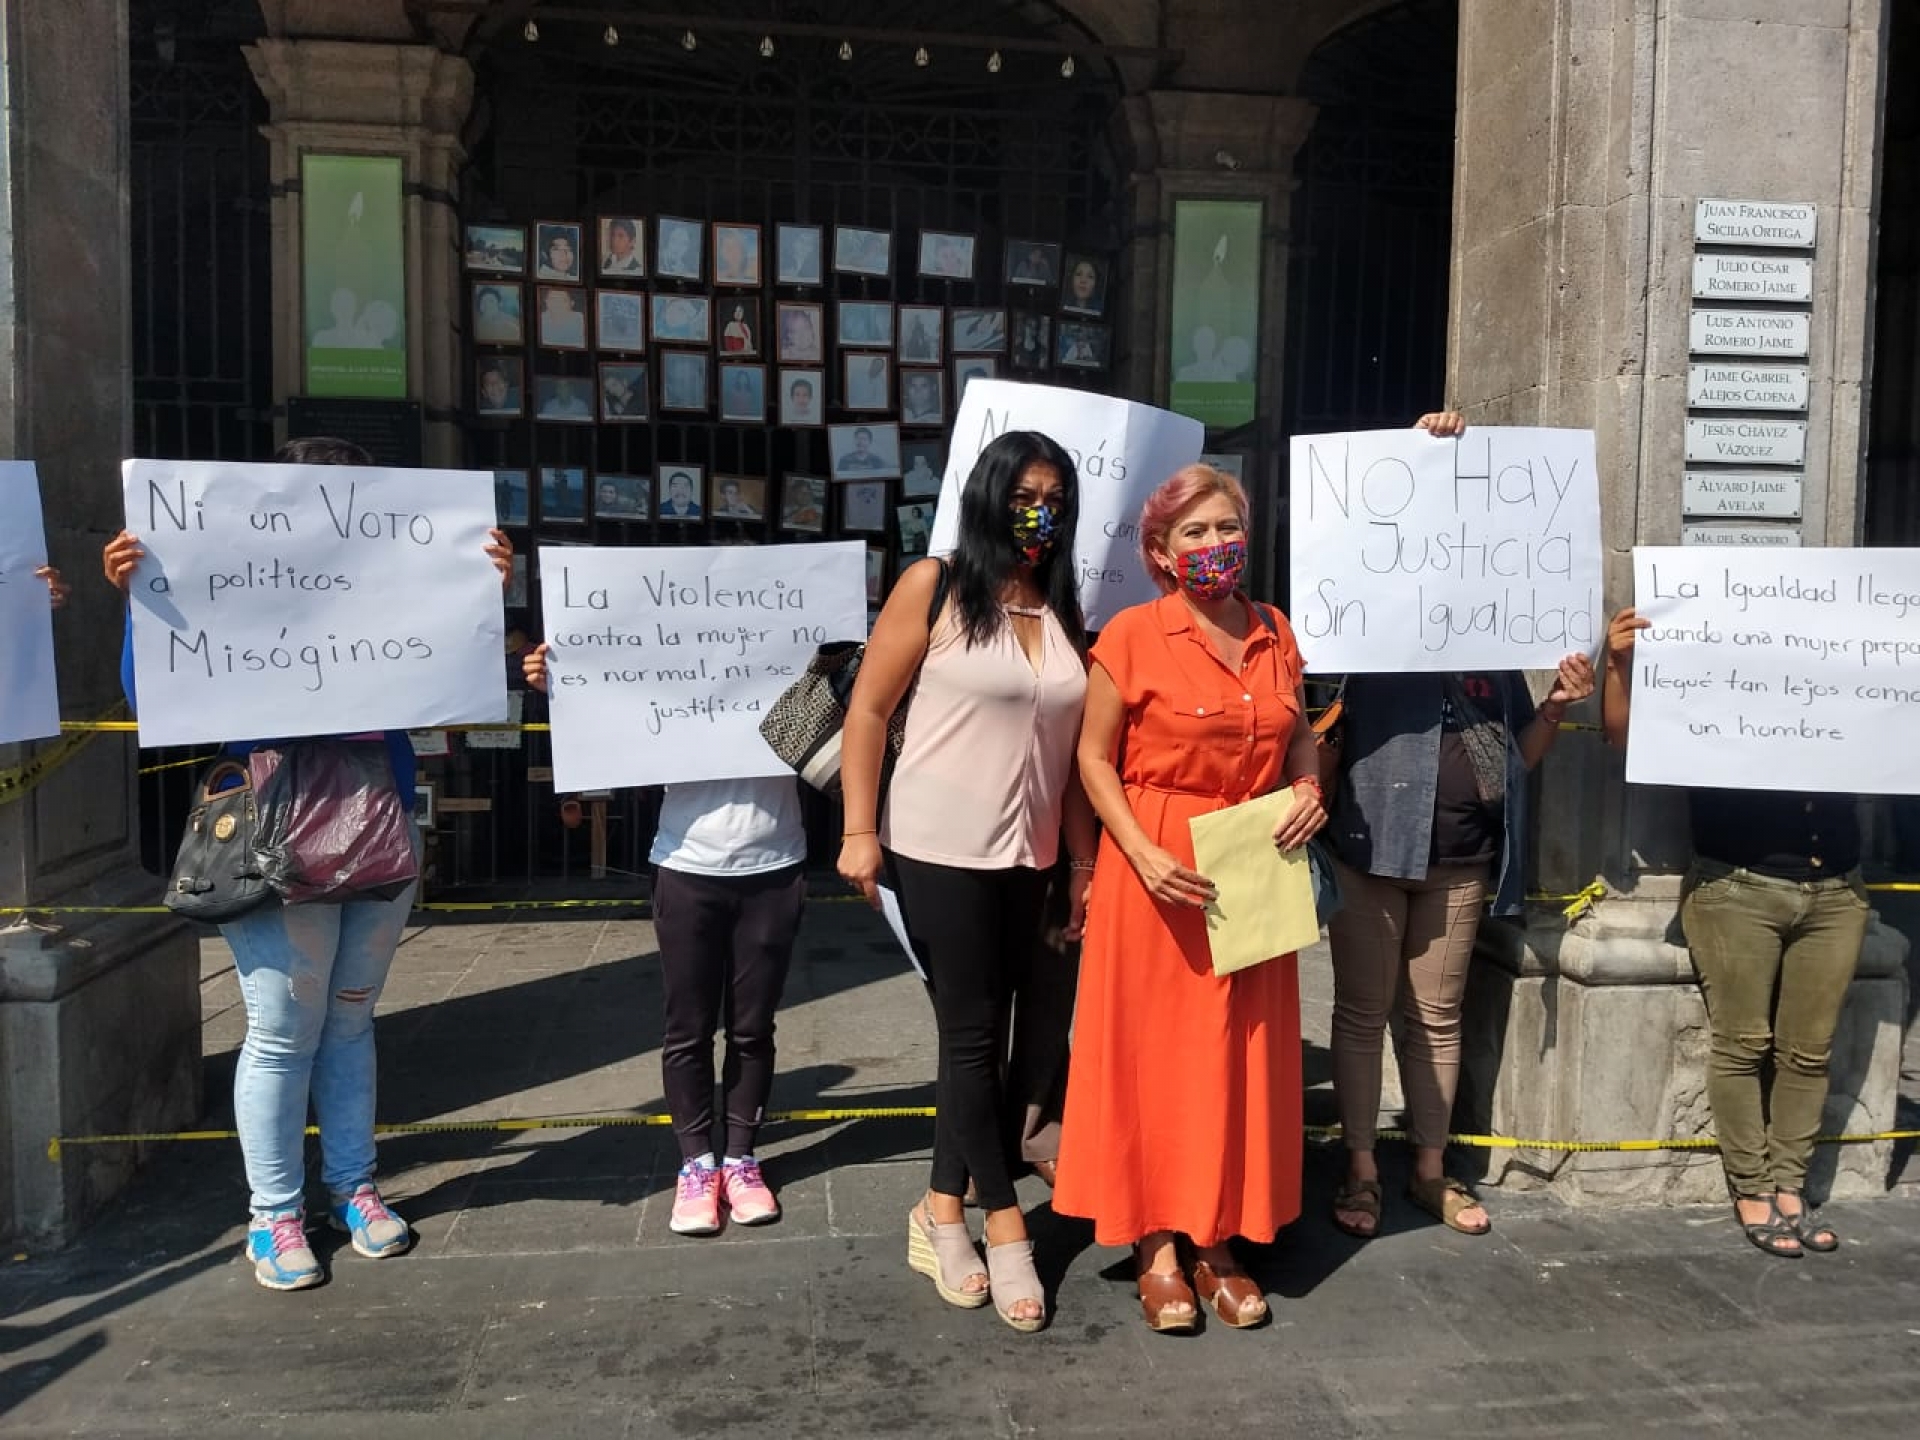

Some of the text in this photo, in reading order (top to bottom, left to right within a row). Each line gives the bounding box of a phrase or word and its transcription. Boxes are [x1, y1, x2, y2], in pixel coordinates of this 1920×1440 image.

[1704, 203, 1807, 220] JUAN FRANCISCO
[1707, 223, 1801, 240] SICILIA ORTEGA
[1716, 259, 1748, 274] JULIO
[1708, 278, 1798, 294] ROMERO JAIME
[1706, 315, 1793, 330] LUIS ANTONIO
[1704, 334, 1794, 349] ROMERO JAIME
[1704, 369, 1791, 384] JAIME GABRIEL
[1744, 389, 1796, 403] CADENA
[1455, 435, 1578, 537] Hay
[1751, 481, 1786, 495] JAIME
[148, 479, 205, 533] Ni
[249, 508, 291, 533] un
[1717, 499, 1765, 511] AVELAR
[1361, 521, 1571, 580] Justicia
[149, 575, 170, 593] a
[563, 566, 804, 610] La Violencia
[1652, 563, 1699, 599] La
[1725, 568, 1837, 612] Igualdad
[1304, 578, 1593, 652] Sin Igualdad
[554, 624, 827, 656] contra la mujer no
[1785, 634, 1850, 660] mujer
[169, 627, 433, 692] Misóginos
[560, 673, 588, 686] es
[724, 663, 751, 679] ni
[765, 665, 796, 677] se
[1725, 669, 1767, 693] tan
[1784, 675, 1839, 705] lejos
[647, 694, 760, 735] justifica
[1689, 715, 1845, 740] un hombre
